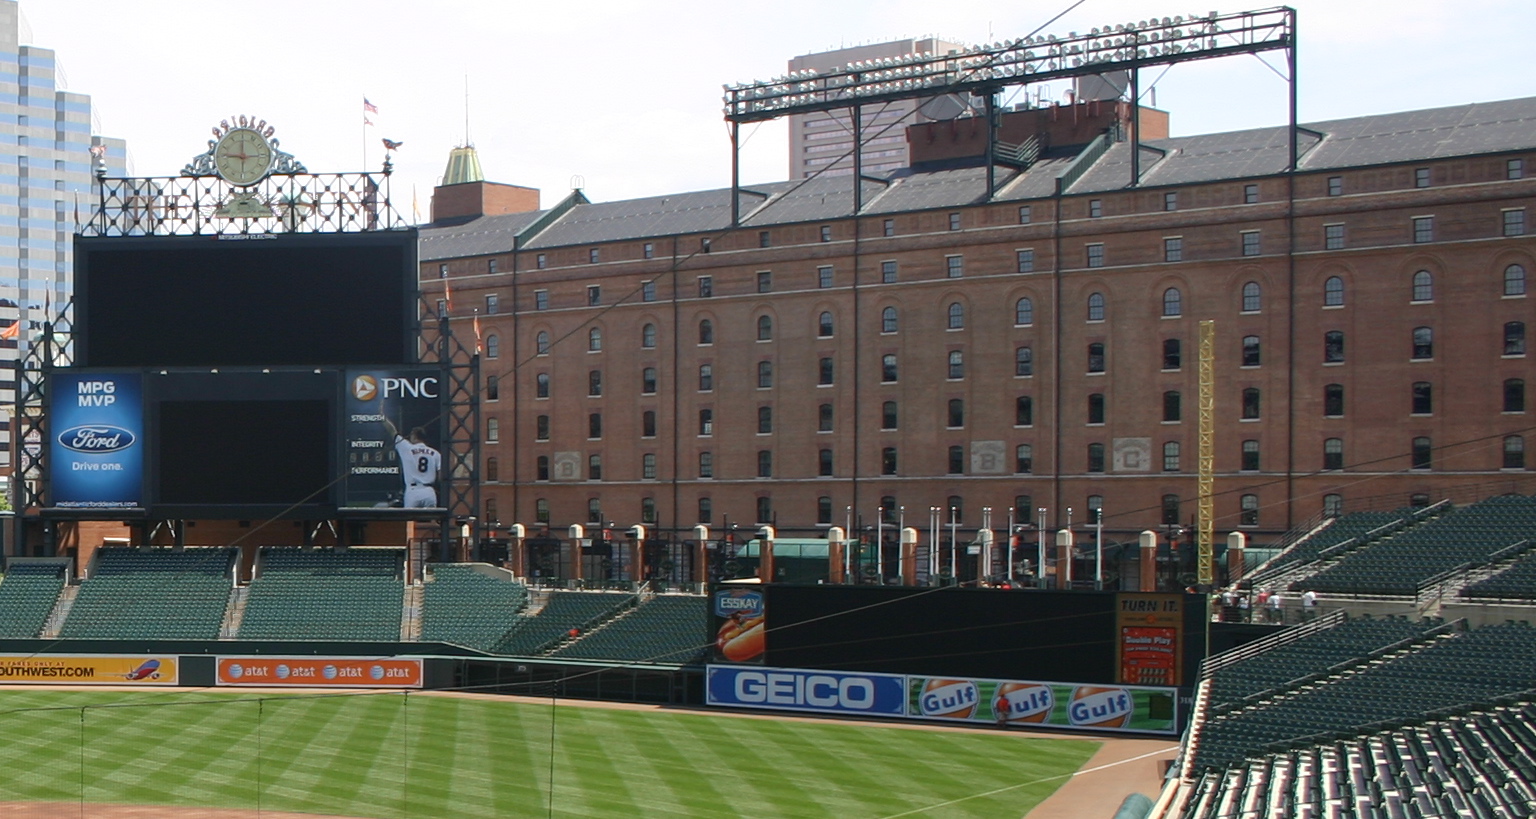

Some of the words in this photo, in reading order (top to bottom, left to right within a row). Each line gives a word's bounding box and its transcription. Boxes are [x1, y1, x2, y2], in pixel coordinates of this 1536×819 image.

[78, 382, 115, 394] MPG
[381, 377, 438, 398] PNC
[78, 395, 115, 407] MVP
[72, 428, 121, 448] Ford
[72, 461, 99, 471] Drive
[101, 463, 123, 471] one.
[418, 456, 429, 473] 8
[721, 597, 758, 608] ESSKAY
[1122, 601, 1156, 612] TURN
[1154, 636, 1172, 645] Play
[245, 666, 268, 677] at&t
[292, 666, 315, 677] at&t
[339, 666, 362, 677] at&t
[386, 667, 409, 678] at&t
[735, 671, 874, 709] GEICO
[924, 687, 973, 712] Gulf
[1071, 694, 1126, 721] Gulf
